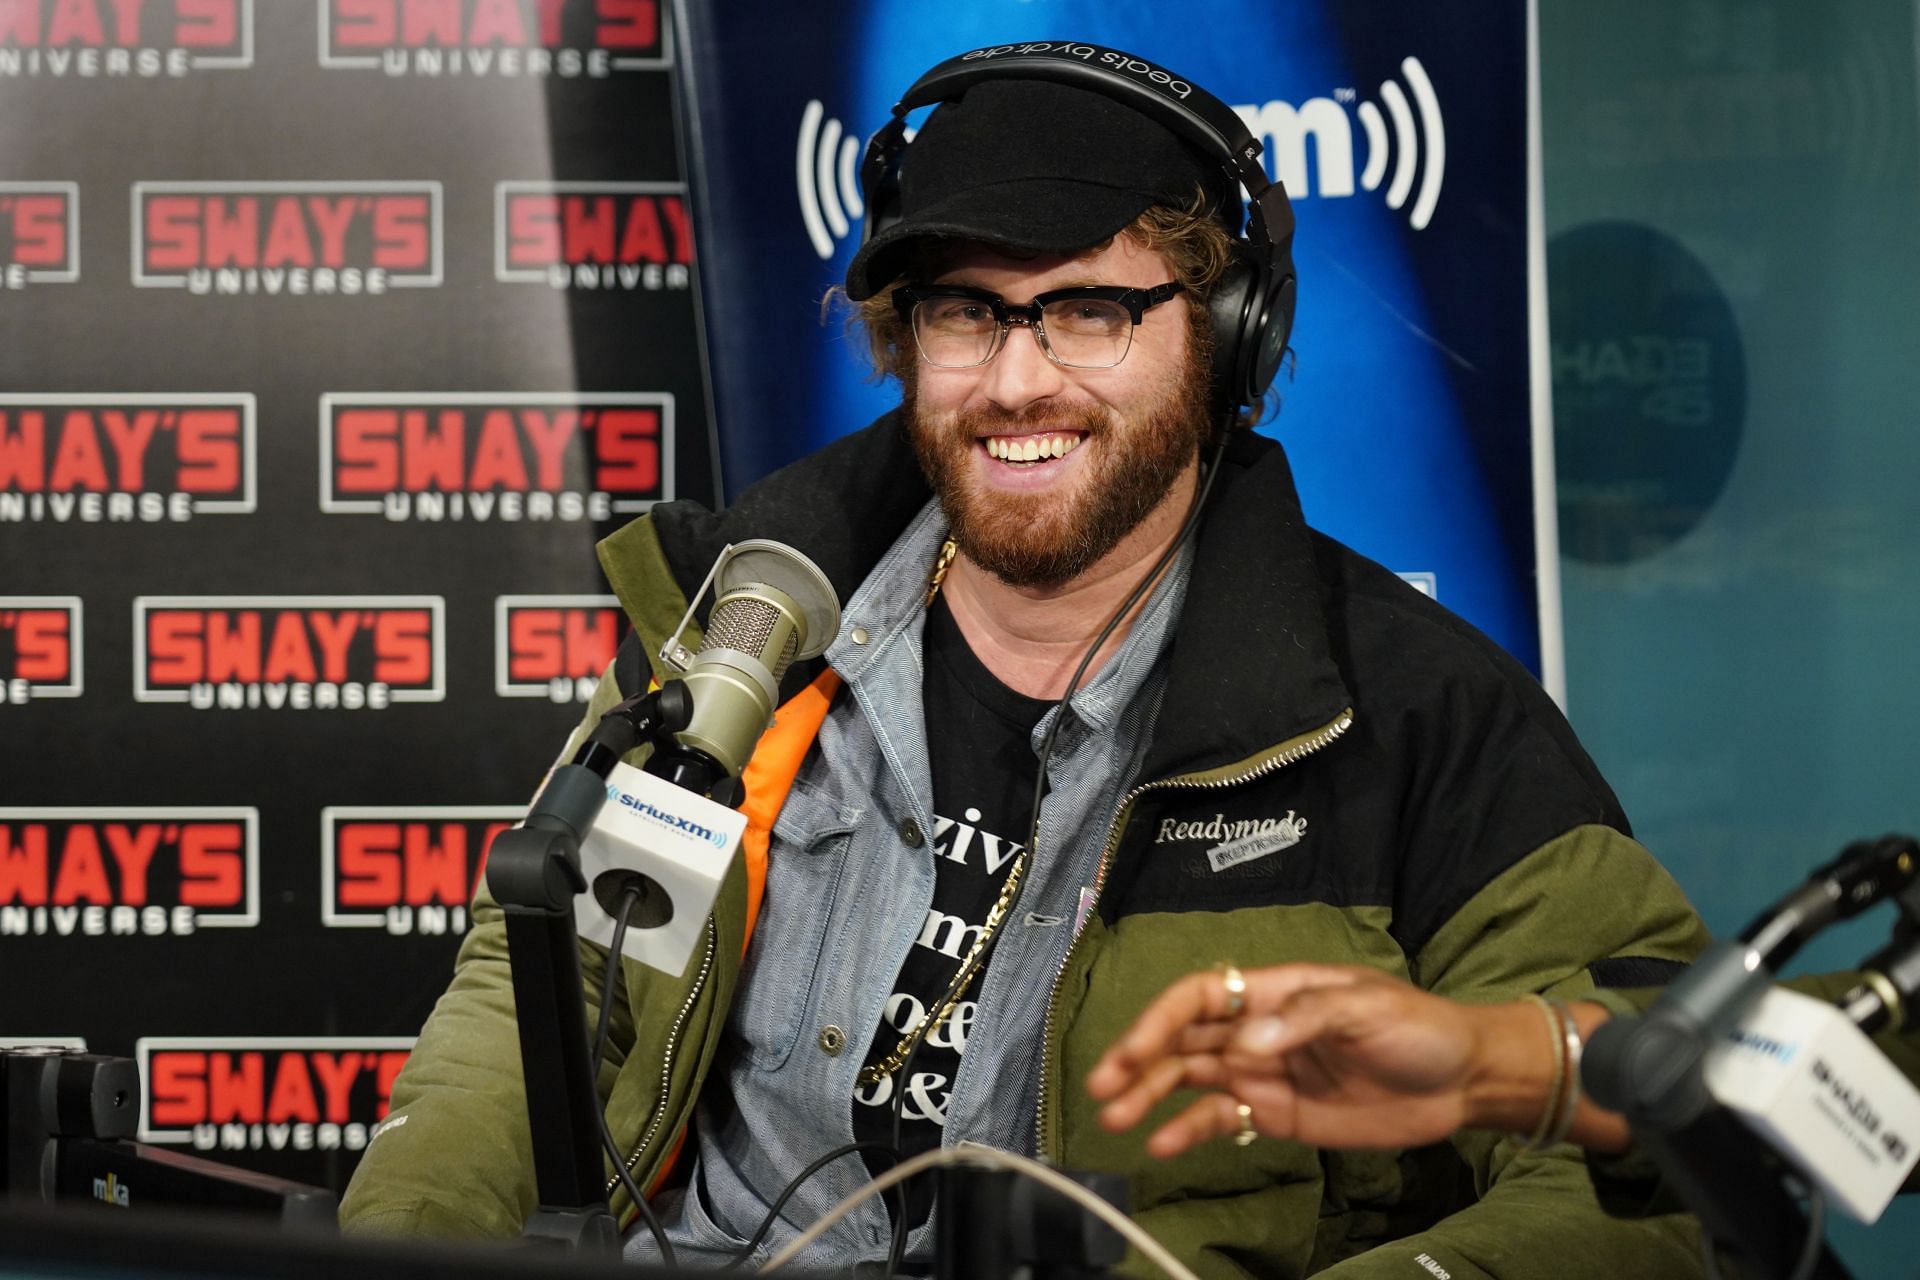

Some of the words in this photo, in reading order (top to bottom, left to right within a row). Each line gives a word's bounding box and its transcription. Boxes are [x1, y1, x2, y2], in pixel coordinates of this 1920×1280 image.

[0, 0, 236, 46] AYS
[336, 0, 656, 47] SWAYS
[383, 49, 611, 77] UNIVERSE
[1054, 43, 1095, 60] by
[1101, 52, 1193, 99] beats
[147, 196, 428, 268] SWAY'S
[186, 268, 388, 295] UNIVERSE
[336, 409, 659, 492] SWAY'S
[384, 493, 611, 521] UNIVERSE
[148, 610, 431, 683] SWAY'S
[189, 682, 389, 709] UNIVERSE
[1155, 810, 1308, 846] Readymade
[193, 1123, 378, 1151] UNIVERS
